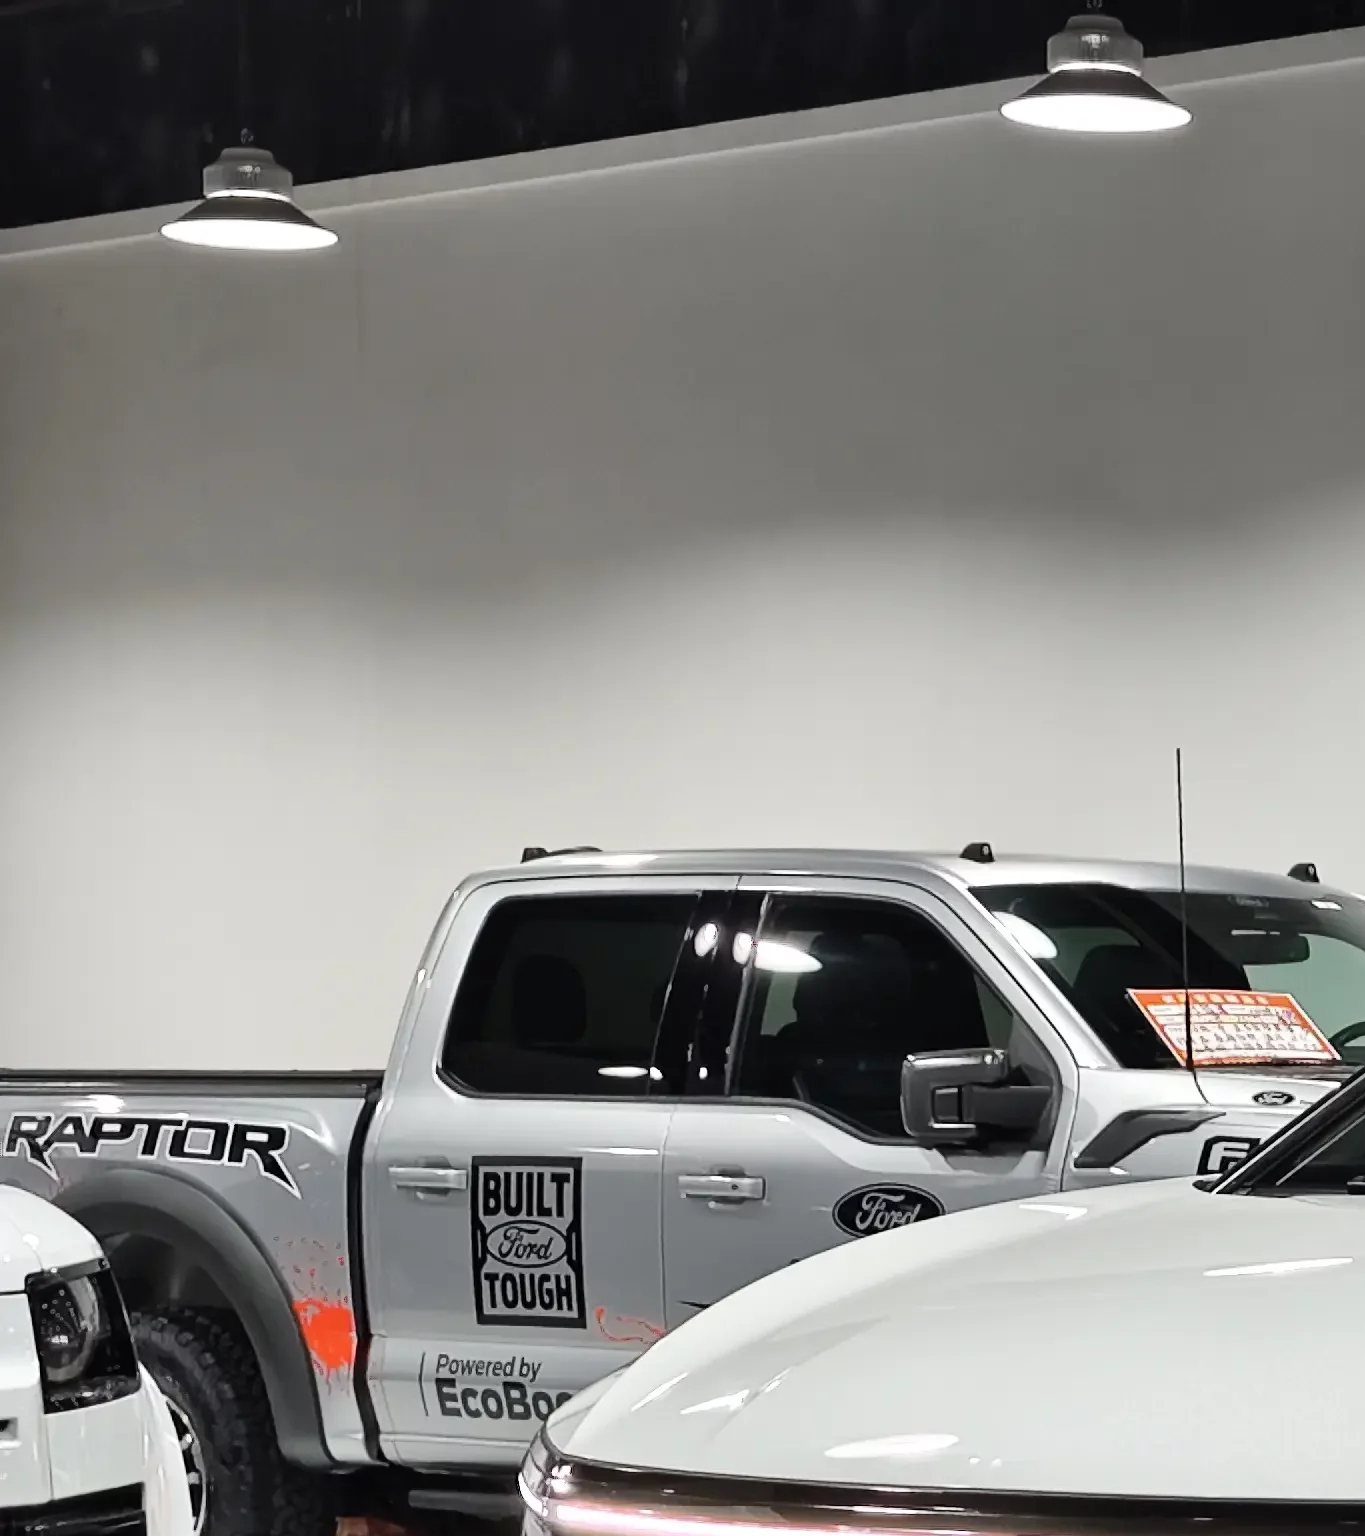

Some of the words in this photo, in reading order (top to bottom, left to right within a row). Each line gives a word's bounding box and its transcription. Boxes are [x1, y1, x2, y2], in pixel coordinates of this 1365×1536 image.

[5, 1112, 302, 1199] RAPTOR
[483, 1171, 571, 1218] BUILT
[855, 1191, 922, 1231] Ford
[498, 1225, 553, 1261] Ford
[484, 1272, 574, 1312] TOUGH
[436, 1353, 516, 1377] Powered
[519, 1356, 543, 1383] by
